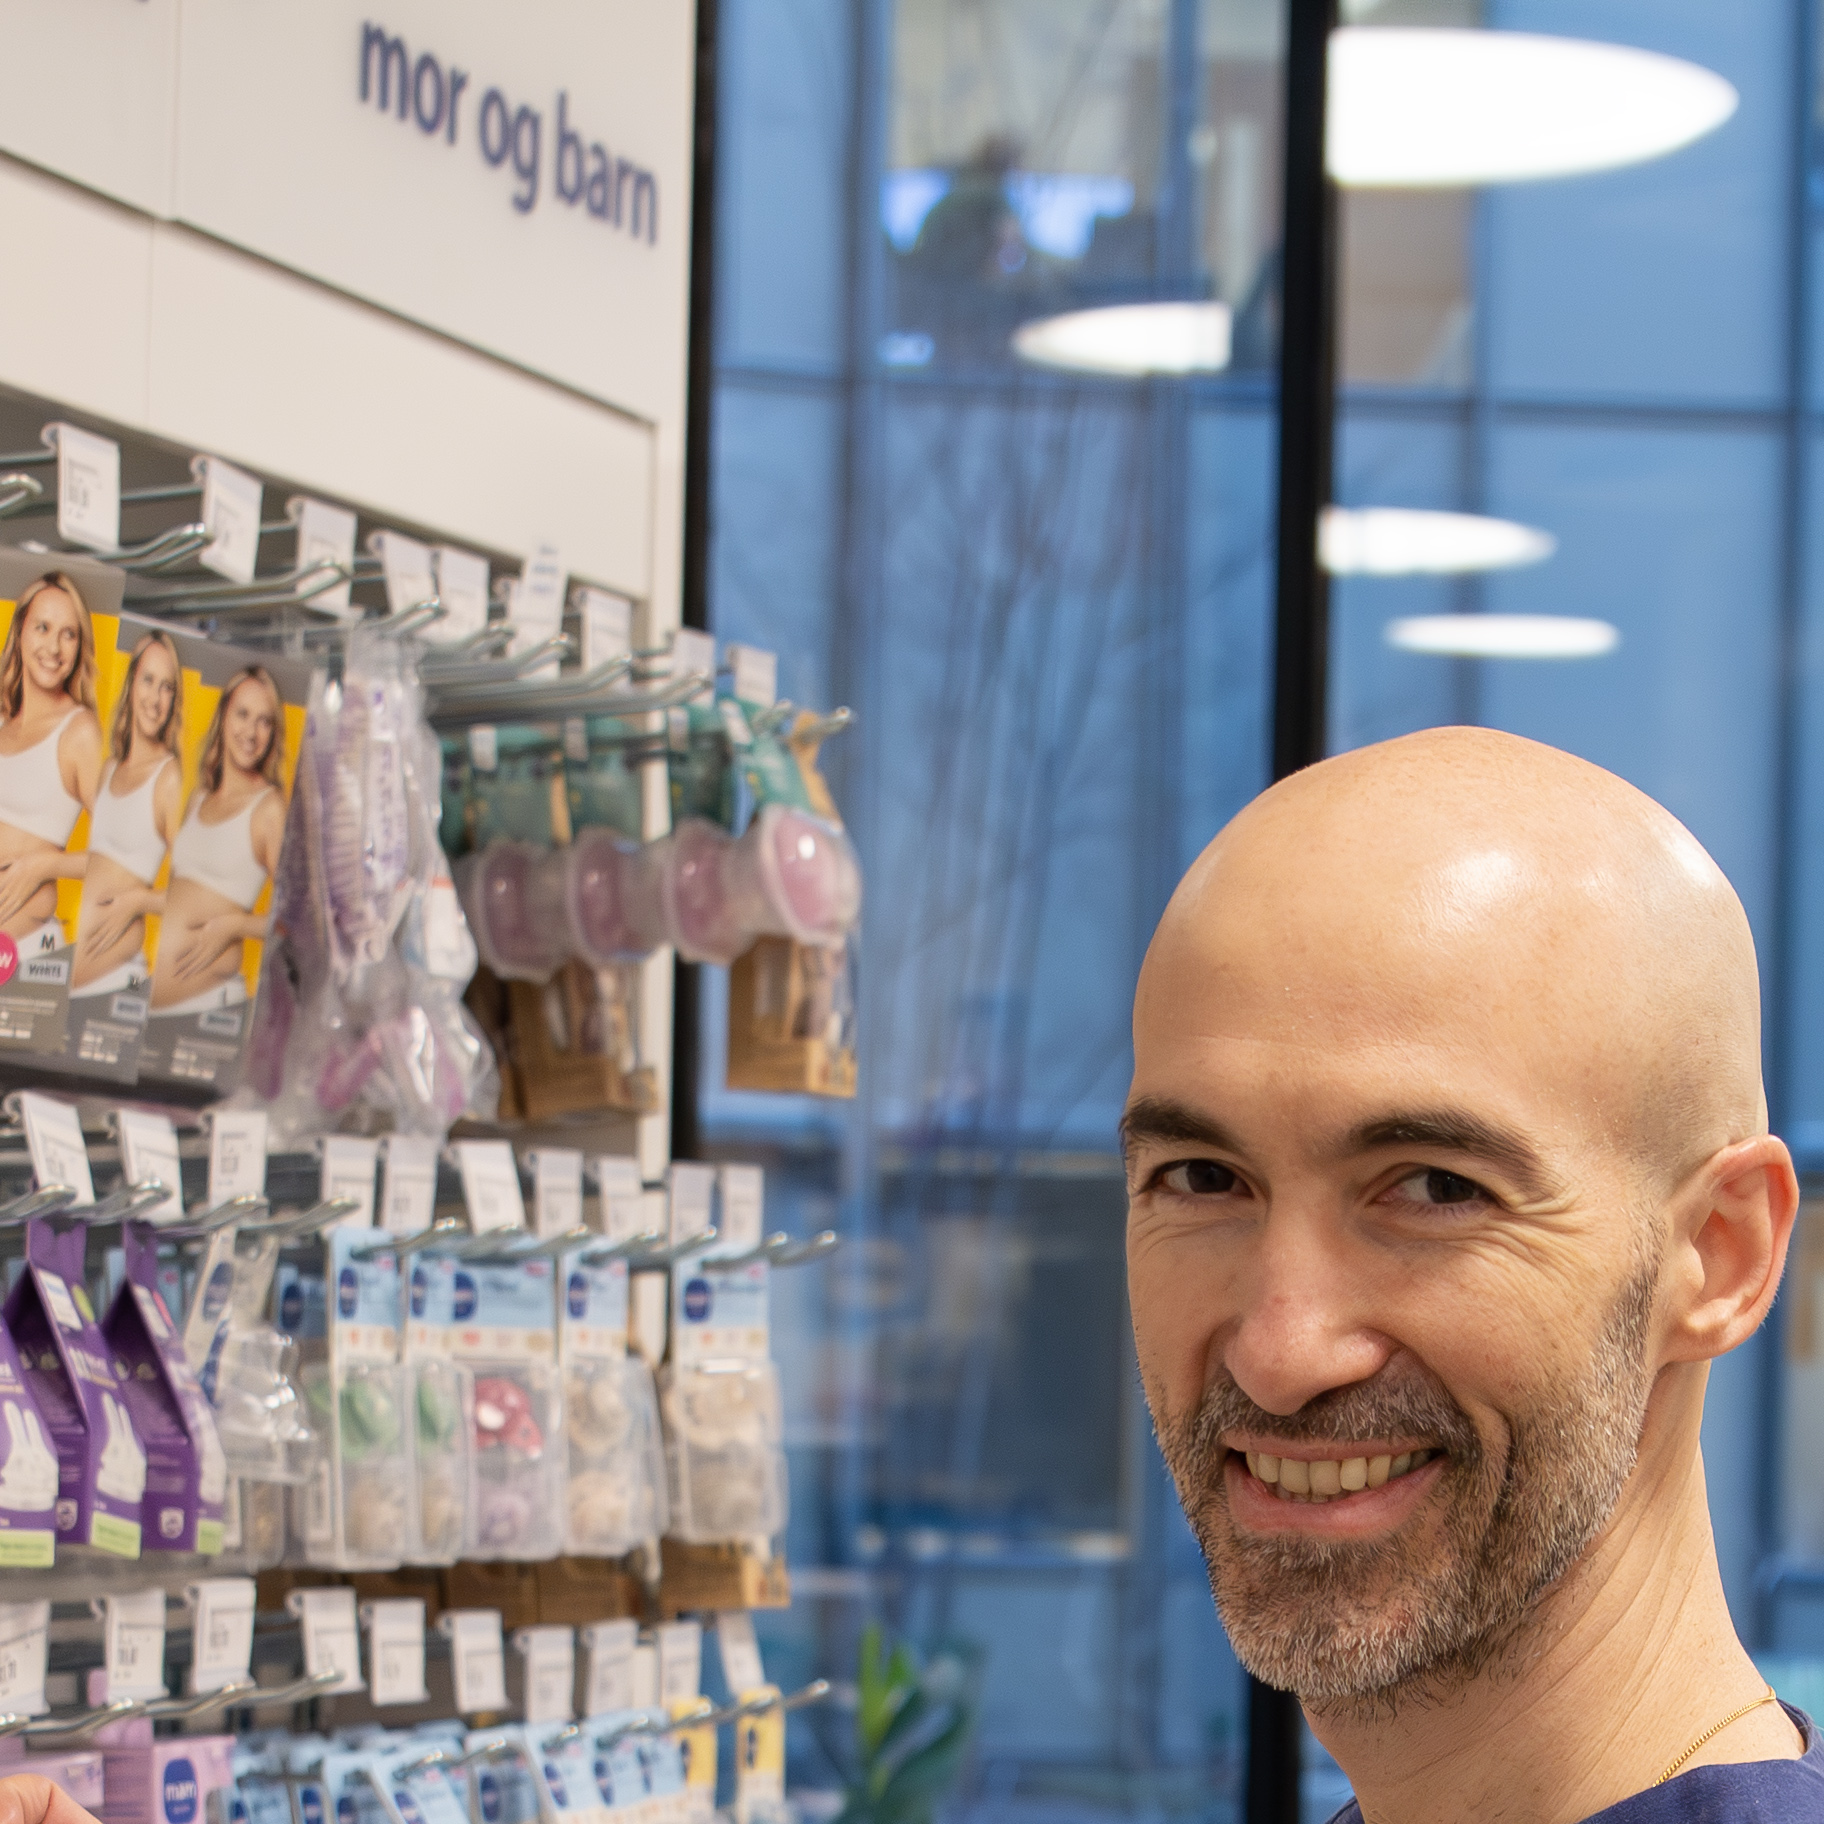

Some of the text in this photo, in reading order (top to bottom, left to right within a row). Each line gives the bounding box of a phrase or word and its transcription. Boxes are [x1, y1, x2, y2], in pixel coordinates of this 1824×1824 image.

[358, 18, 657, 249] mor og barn
